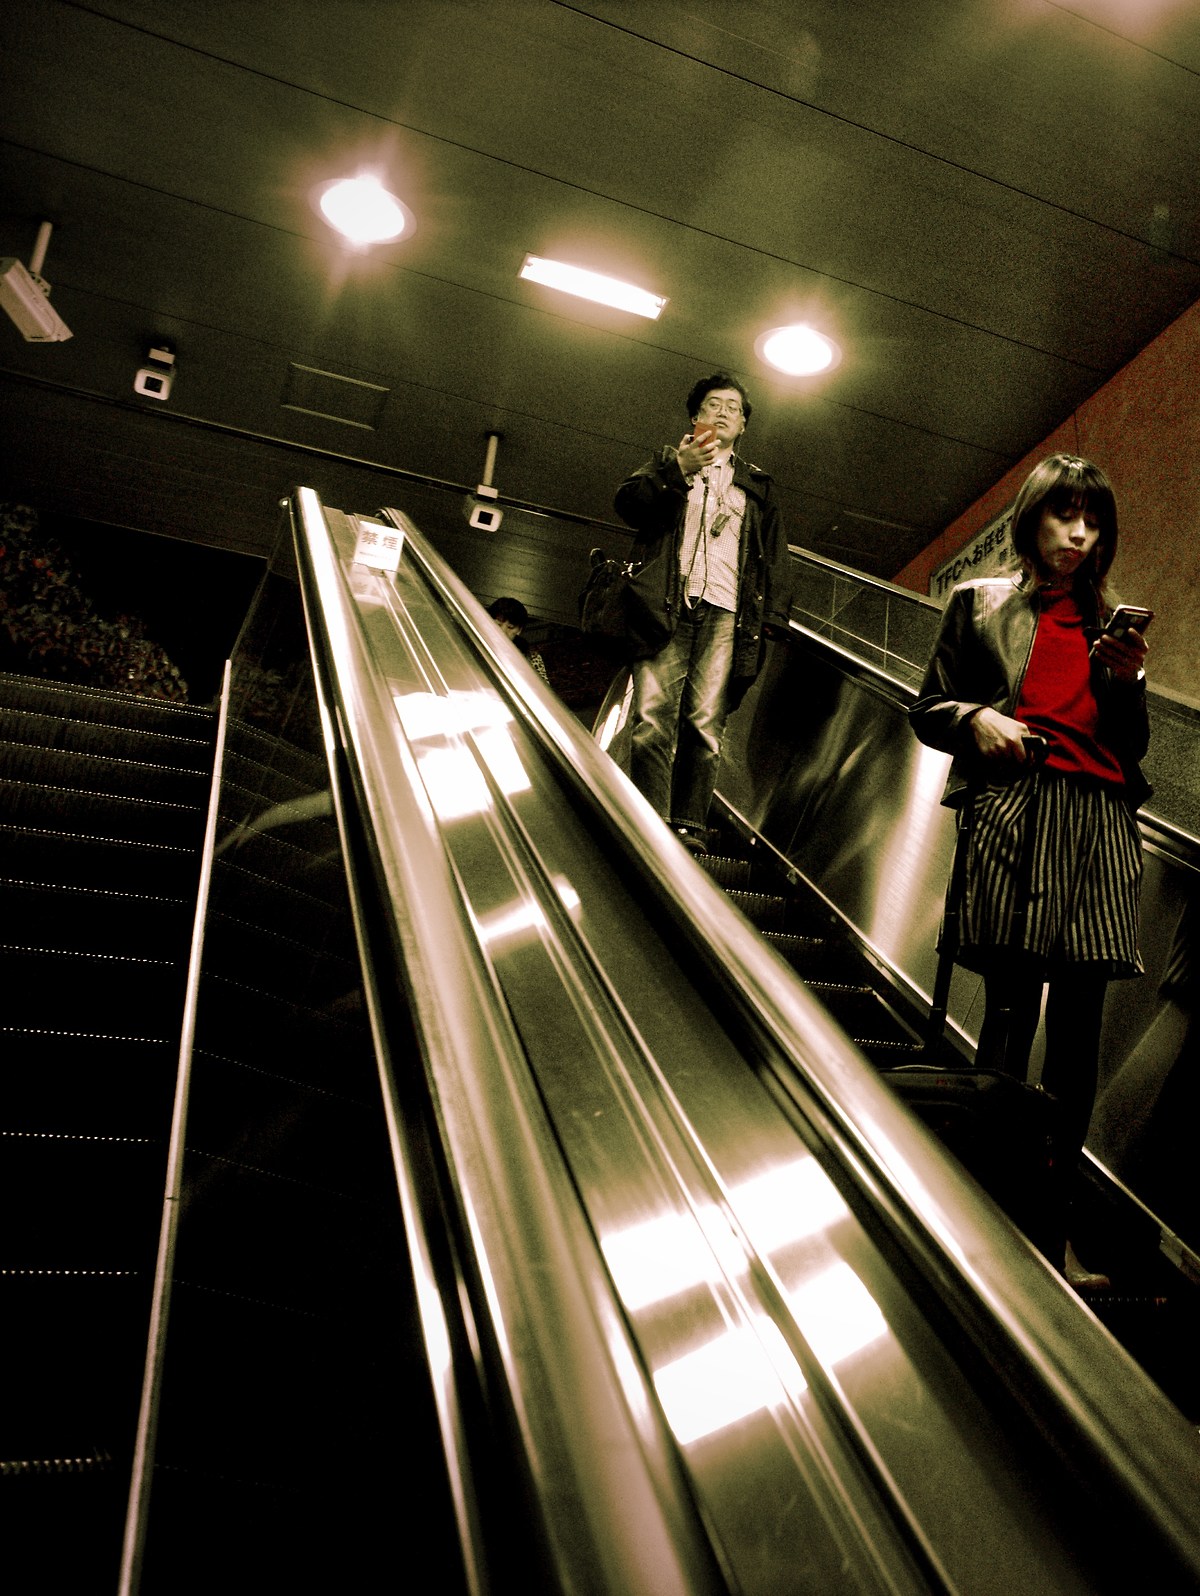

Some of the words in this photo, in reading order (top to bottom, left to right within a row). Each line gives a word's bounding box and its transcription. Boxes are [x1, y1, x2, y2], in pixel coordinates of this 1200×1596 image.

[360, 529, 399, 551] 禁煙
[936, 515, 1013, 594] TFCへお任せ
